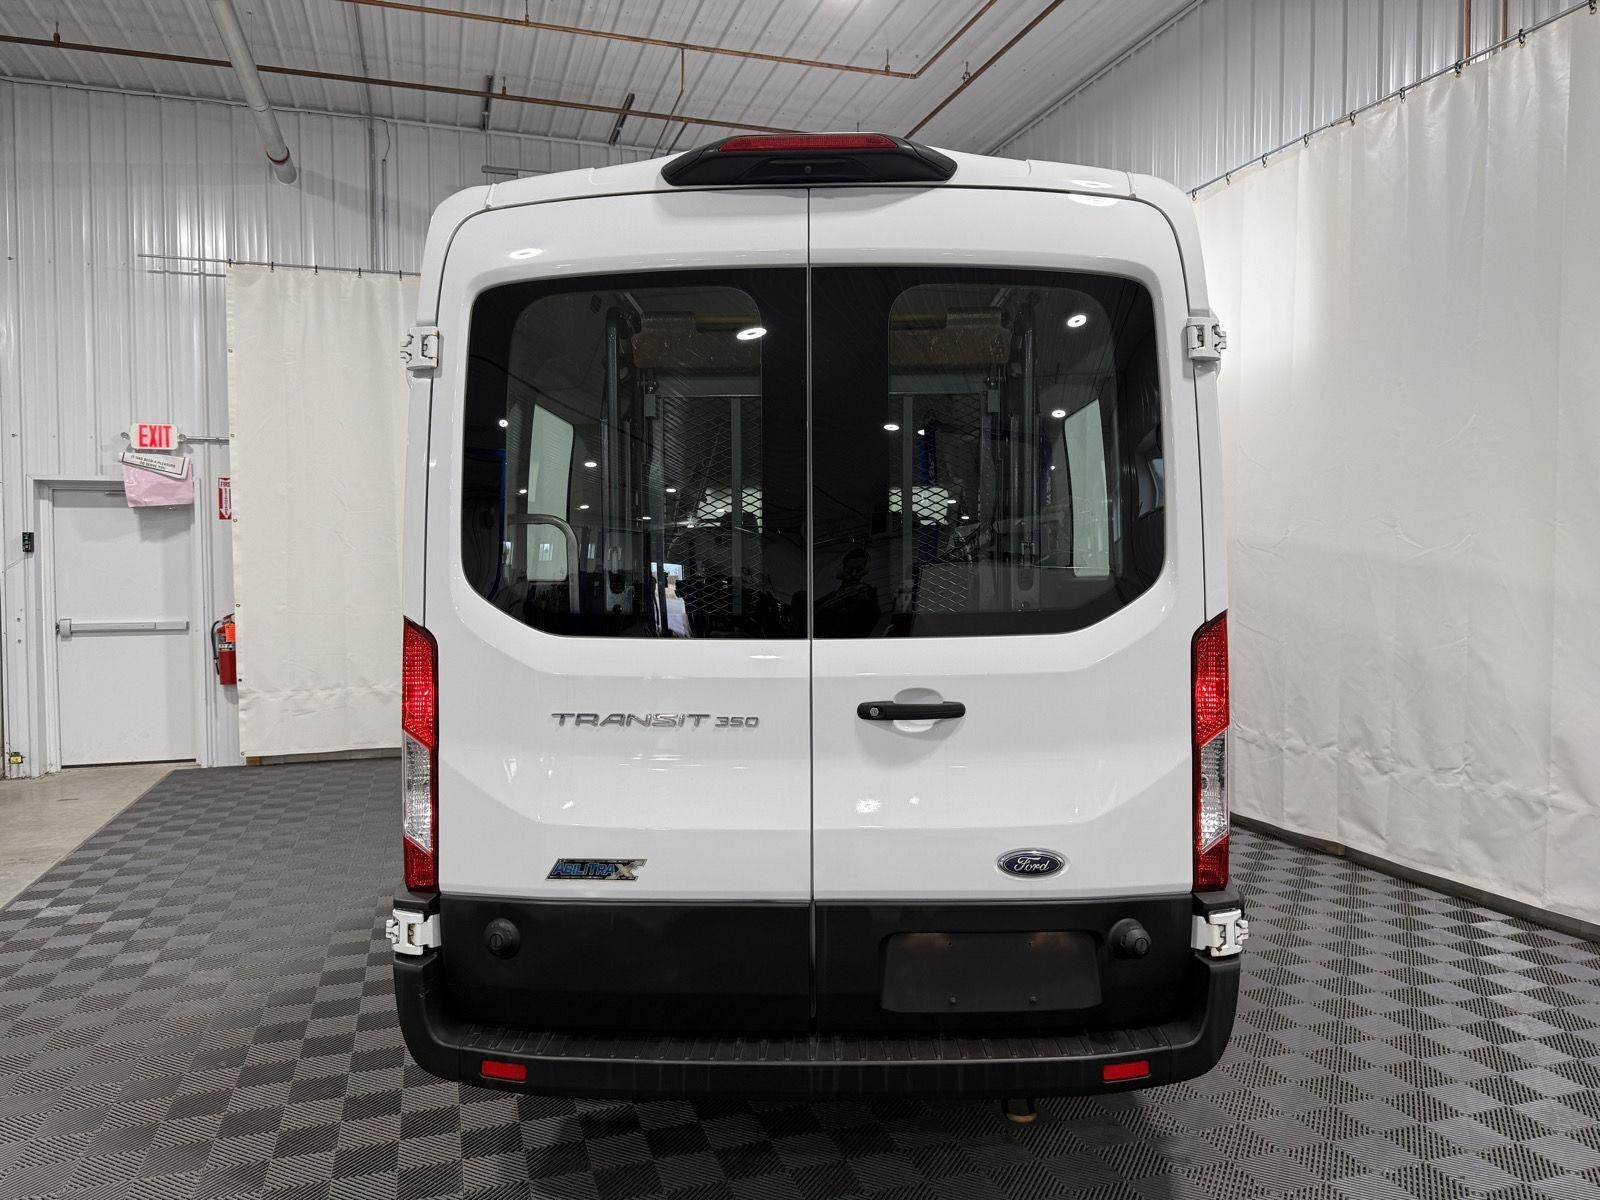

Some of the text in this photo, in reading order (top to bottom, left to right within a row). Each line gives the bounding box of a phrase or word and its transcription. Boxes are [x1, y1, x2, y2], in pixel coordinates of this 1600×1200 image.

[138, 424, 172, 448] EXIT
[551, 713, 759, 728] TRANSIT 350
[1014, 856, 1050, 872] Ford
